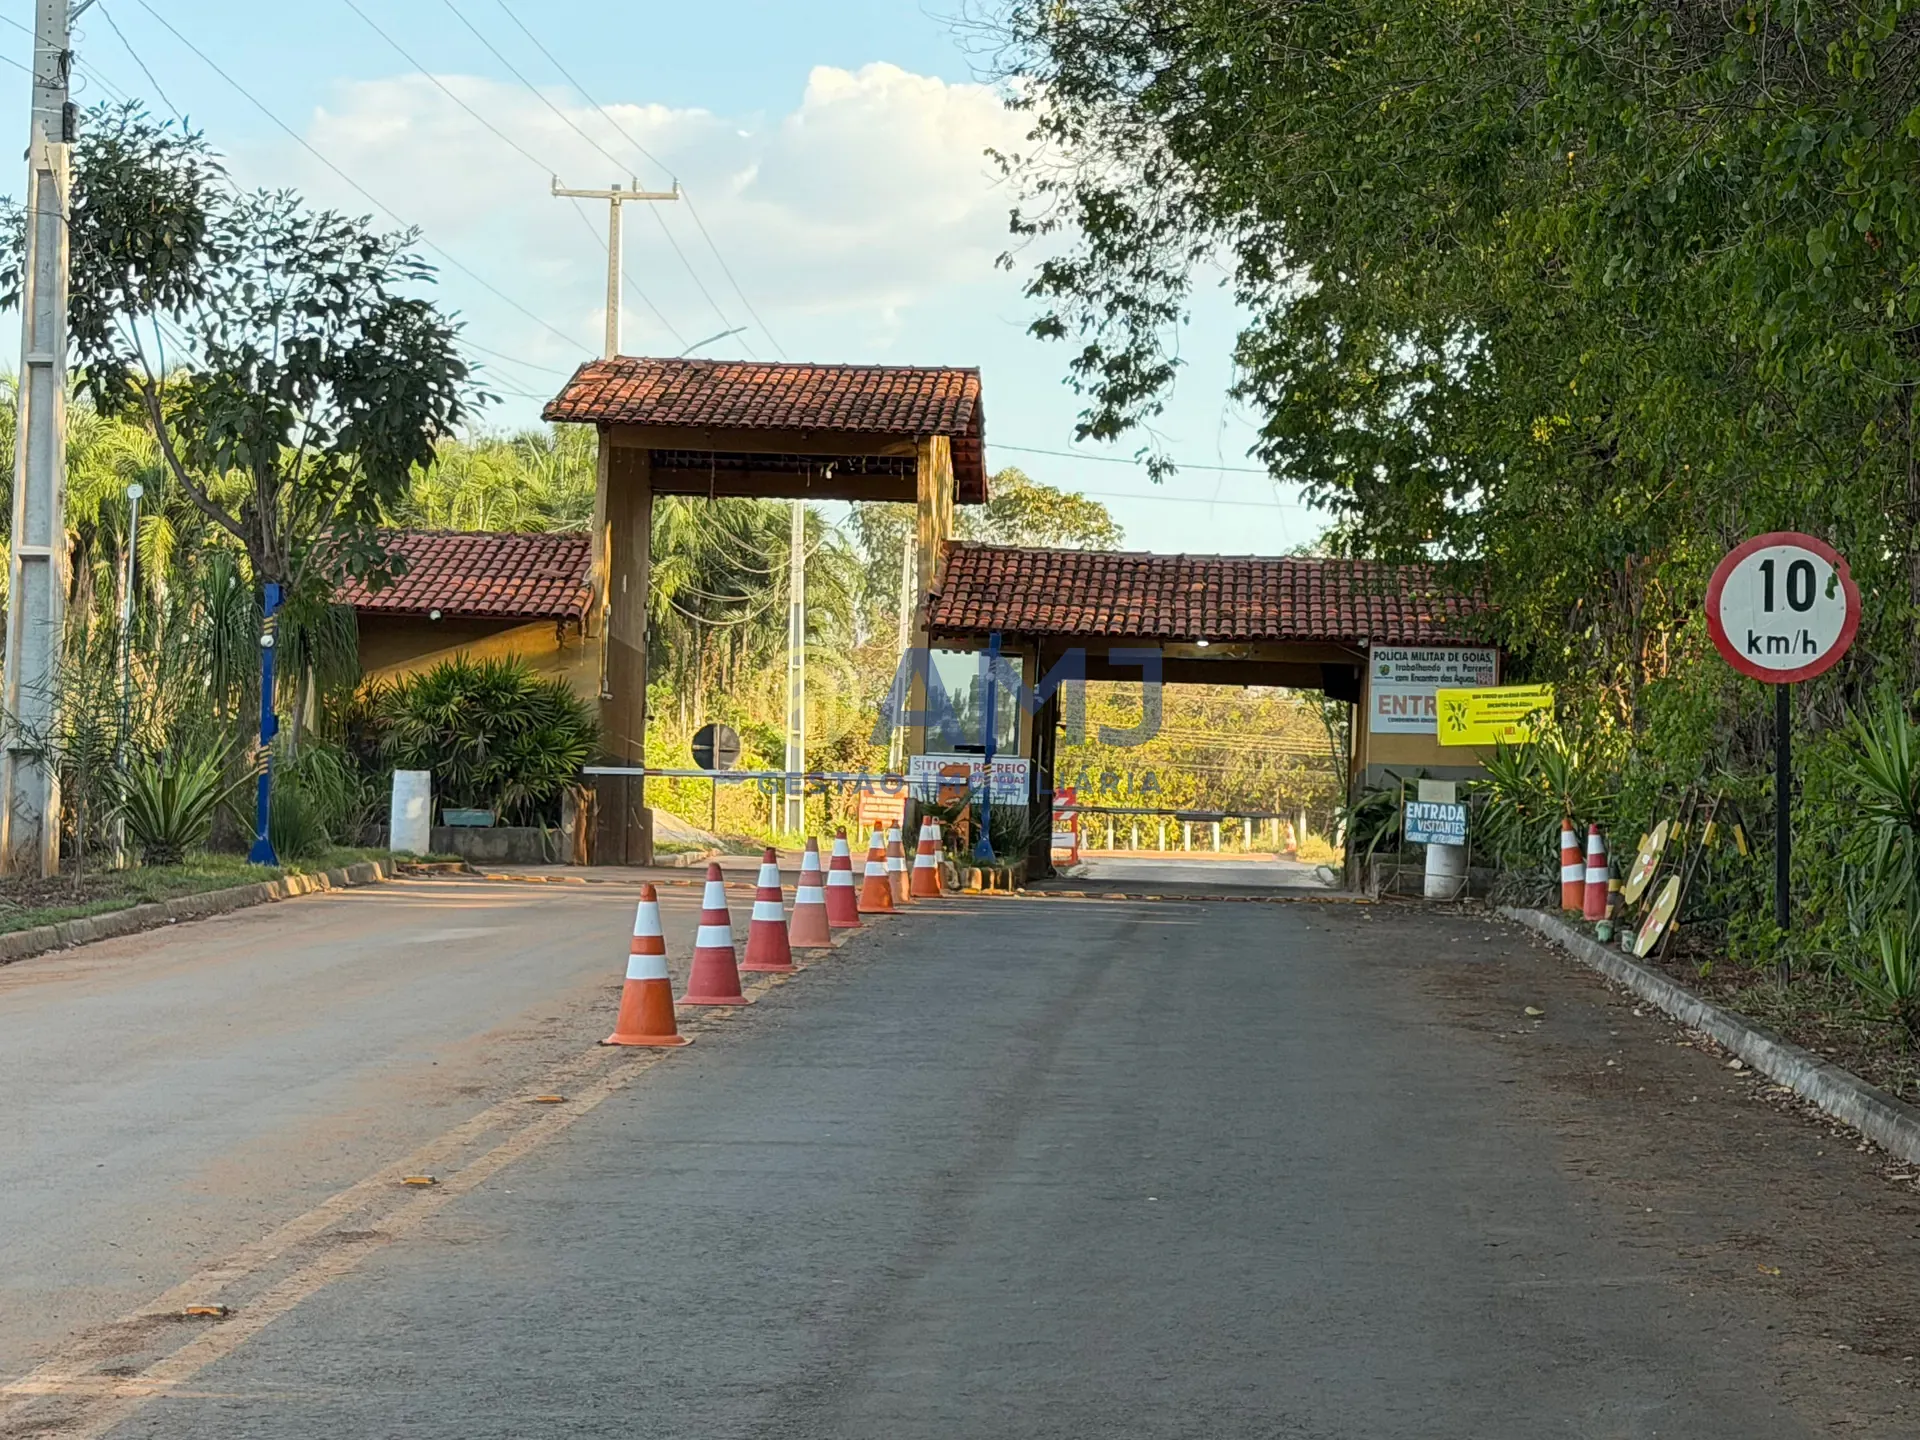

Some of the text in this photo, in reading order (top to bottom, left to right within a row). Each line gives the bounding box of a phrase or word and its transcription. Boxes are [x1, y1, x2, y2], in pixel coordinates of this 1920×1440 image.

[1758, 559, 1817, 613] 10
[1747, 629, 1818, 655] km/h
[1373, 650, 1493, 664] POLÍCIA MILITAR DE GOIÁS,
[1446, 665, 1458, 673] em
[1462, 663, 1493, 673] Parceria
[1395, 675, 1409, 683] com
[1410, 673, 1439, 683] Encontro
[1440, 673, 1453, 683] das
[1378, 694, 1437, 716] ENTR
[1406, 802, 1466, 822] ENTRADA
[1417, 819, 1466, 835] VISITANTES
